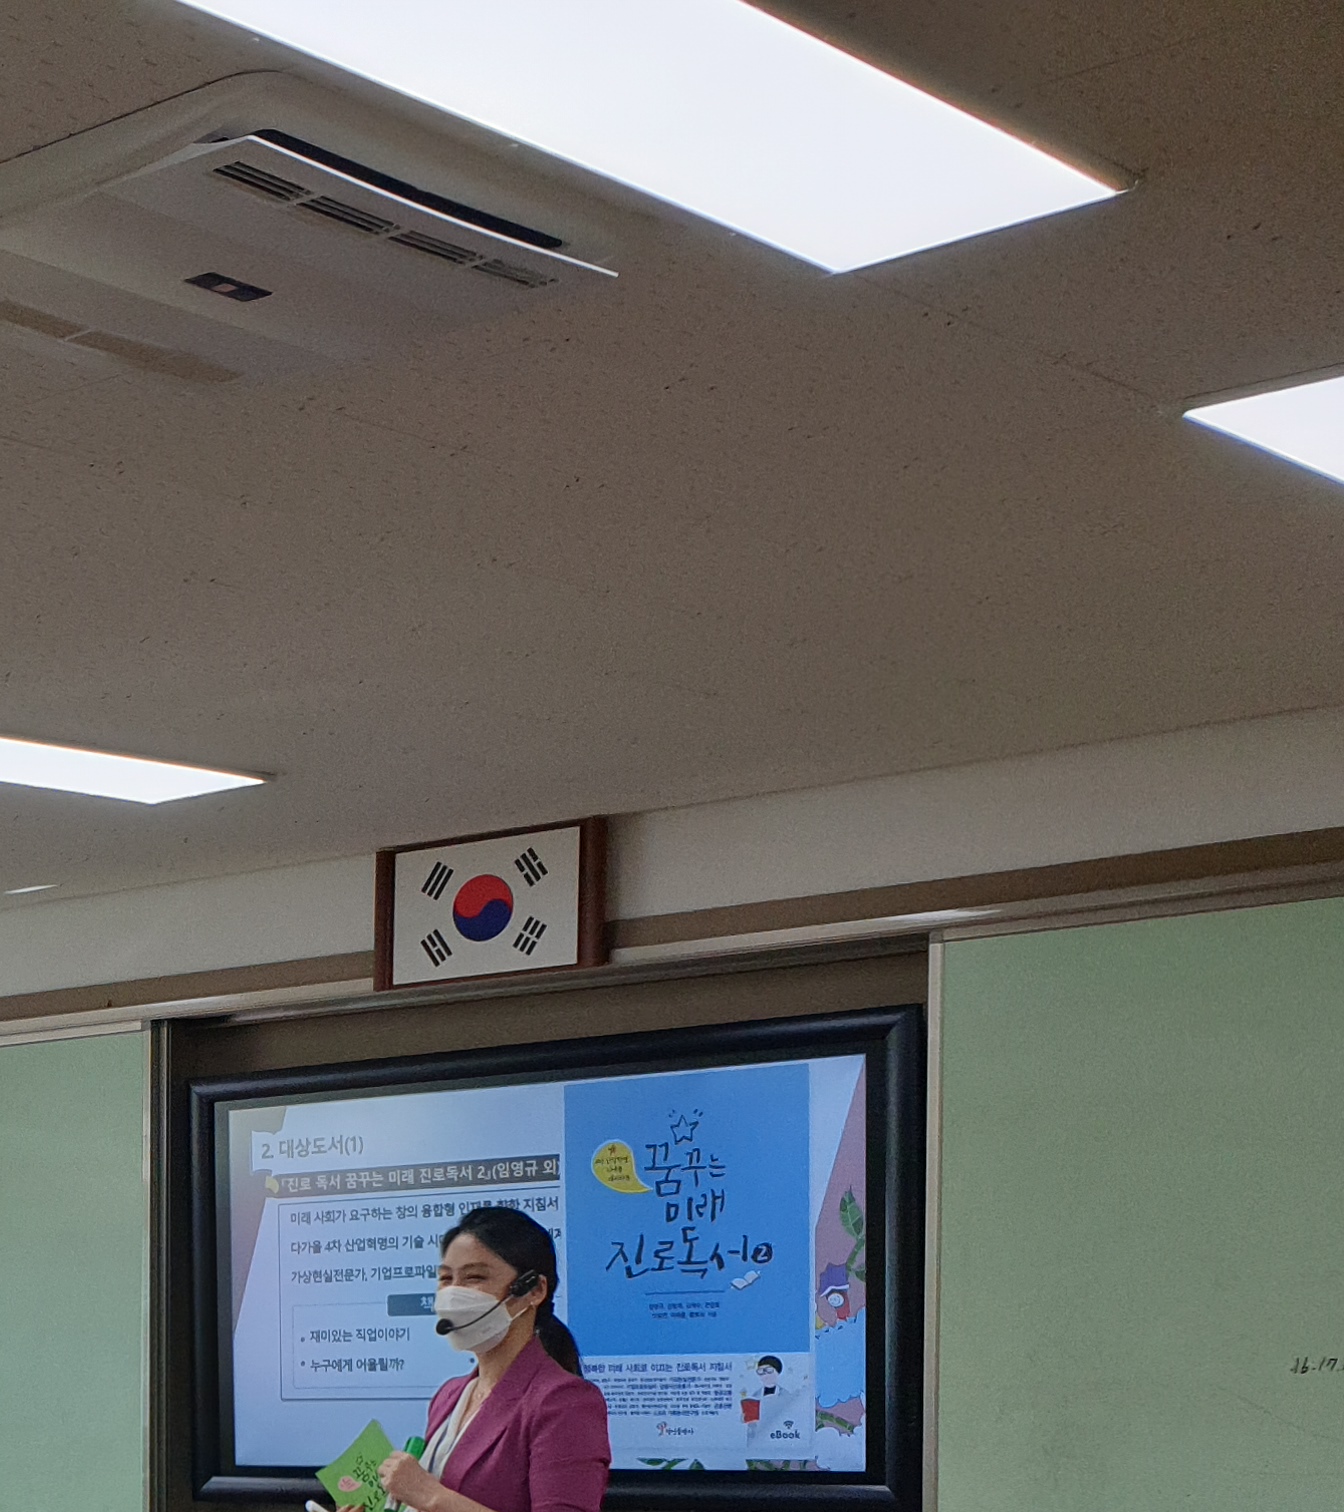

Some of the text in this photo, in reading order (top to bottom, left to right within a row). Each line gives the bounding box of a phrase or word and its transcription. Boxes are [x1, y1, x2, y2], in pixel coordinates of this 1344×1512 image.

[261, 1134, 364, 1159] 2. 대상도서(1)
[315, 1174, 341, 1190] 독서
[345, 1171, 384, 1189] 꿈꾸는
[388, 1168, 415, 1186] 미래
[419, 1164, 473, 1184] 진로독서
[645, 1142, 726, 1197] 꿈꾸는
[290, 1211, 311, 1226] 미래
[314, 1209, 347, 1224] 사회가
[349, 1207, 393, 1222] 요구하는
[395, 1205, 418, 1220] 창의
[523, 1196, 559, 1212] 지침서
[666, 1188, 725, 1222] 미래
[324, 1239, 342, 1252] 4차
[344, 1235, 399, 1252] 산업혁명의
[402, 1234, 424, 1250] 기술
[605, 1227, 749, 1280] 진로독서
[371, 1264, 438, 1281] 기업프로파일
[310, 1327, 410, 1343] 재미있는 직업이야기
[310, 1358, 353, 1372] 누구에게
[770, 1429, 801, 1440] eBook
